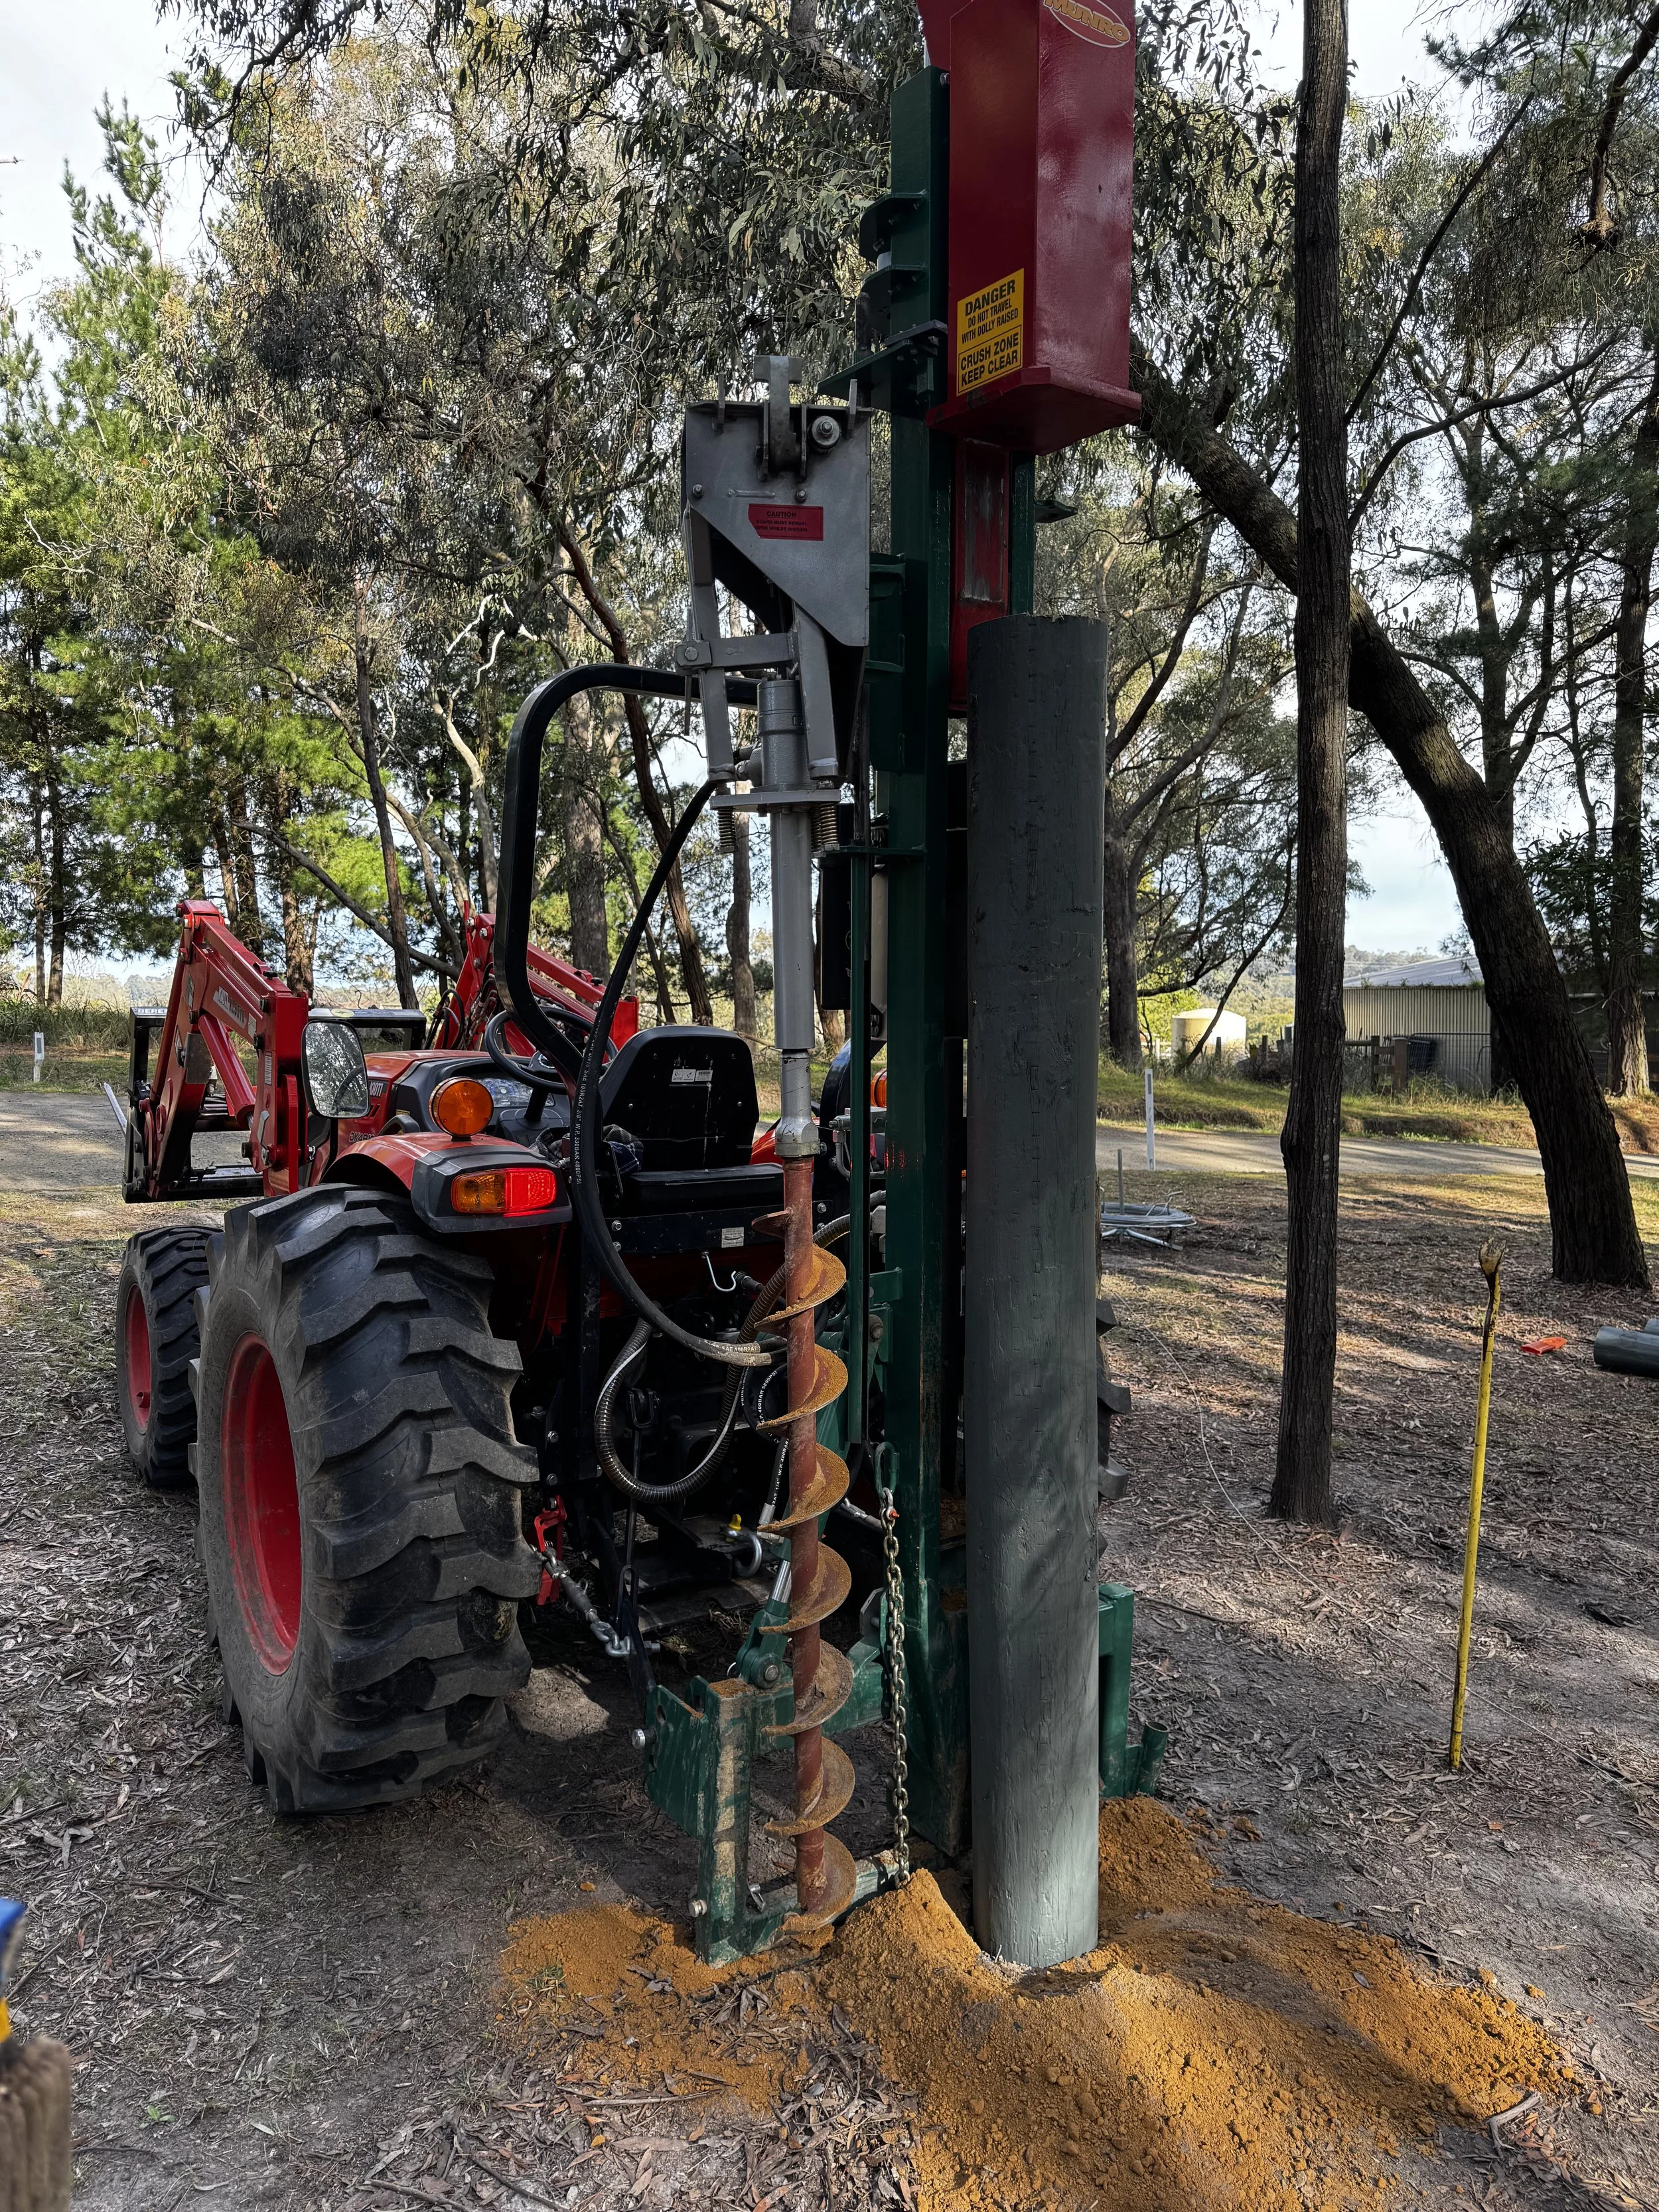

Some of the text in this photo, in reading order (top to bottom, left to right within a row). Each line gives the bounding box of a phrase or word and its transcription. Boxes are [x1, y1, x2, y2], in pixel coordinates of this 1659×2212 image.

[965, 279, 1015, 317] DANGER
[968, 299, 1011, 329] DO NOT TRAVEL
[962, 308, 1019, 344] WITH DOLLY RAISED
[961, 332, 1019, 370] CRUSH ZONE
[961, 349, 1018, 387] KEEP CLEAR
[369, 1082, 383, 1096] KIOTI
[577, 1083, 587, 1107] 100R2AT
